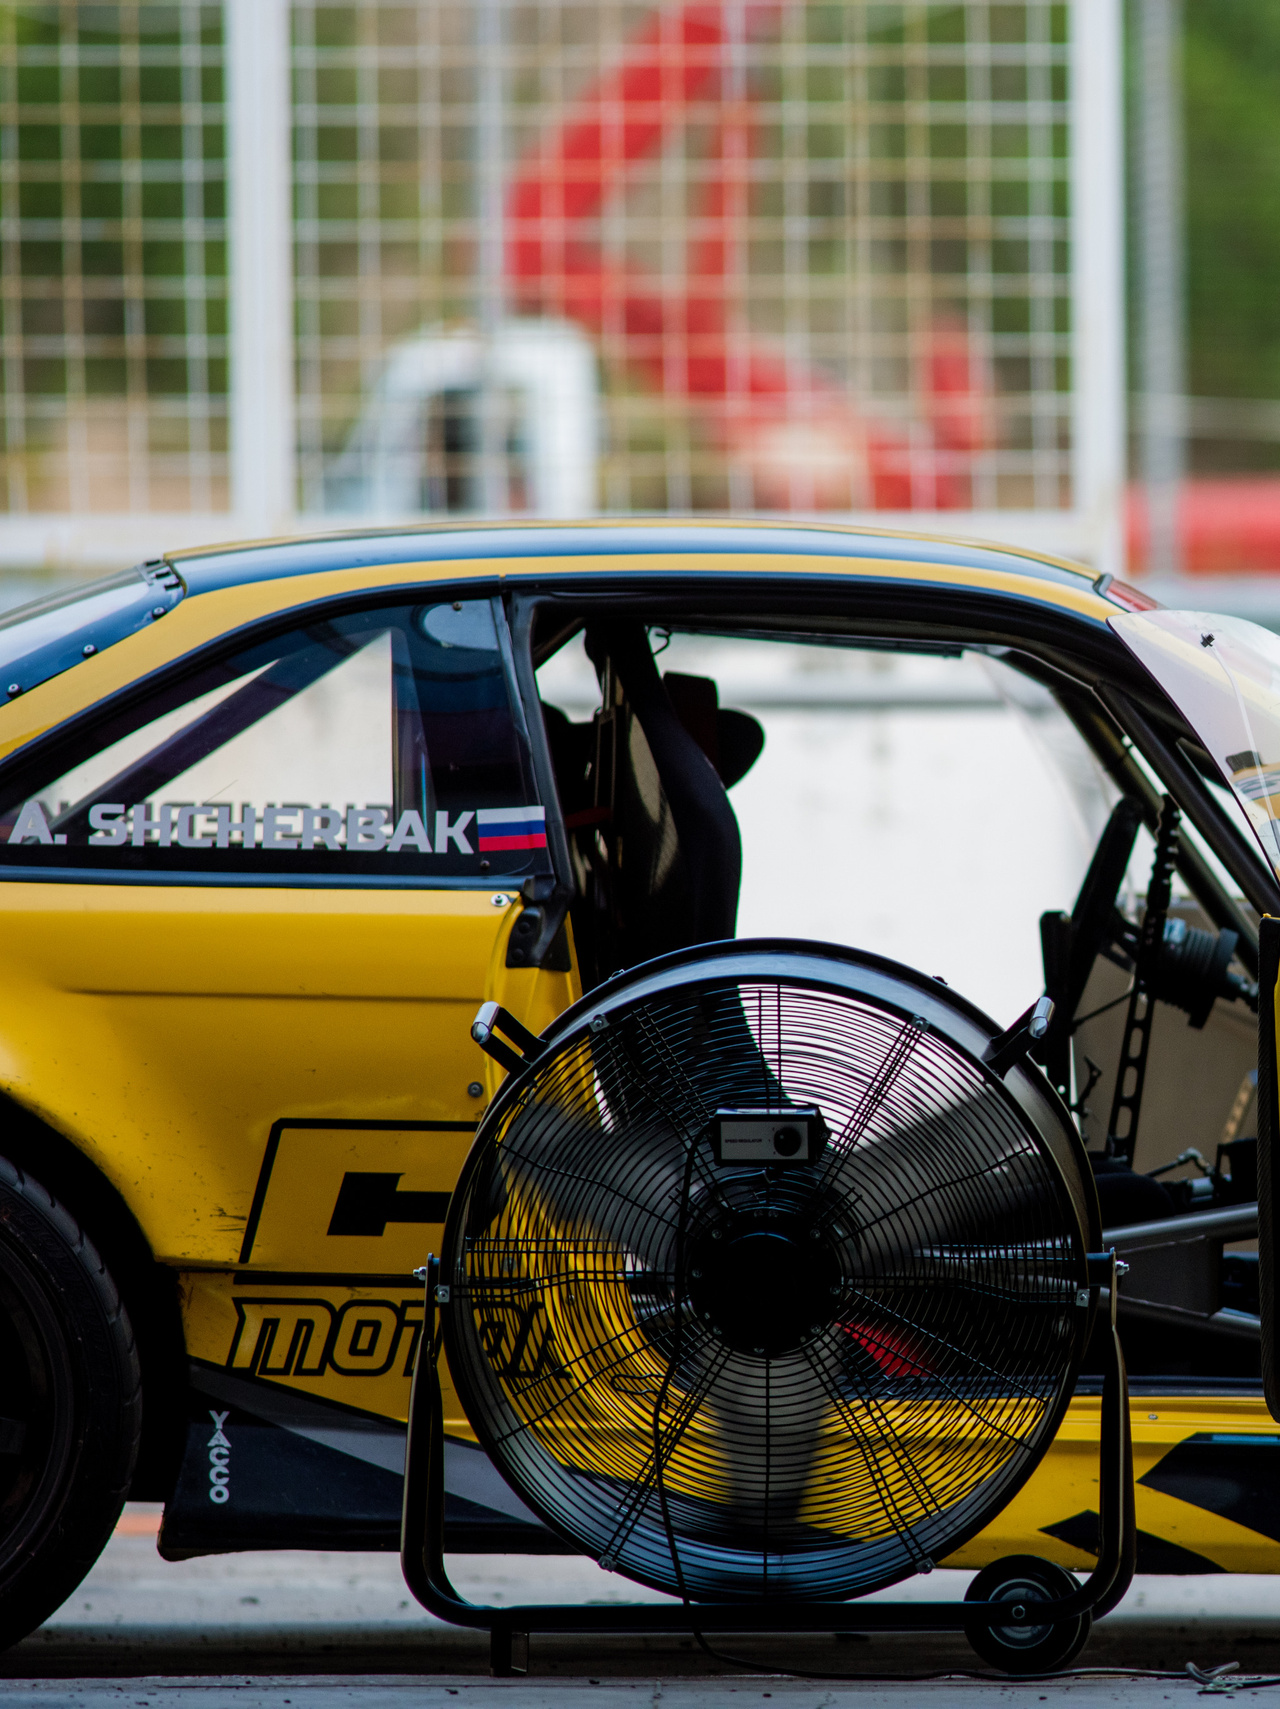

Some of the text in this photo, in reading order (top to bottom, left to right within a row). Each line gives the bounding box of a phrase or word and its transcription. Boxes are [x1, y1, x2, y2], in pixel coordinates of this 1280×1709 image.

[7, 802, 475, 854] A. SHCHERBAK
[206, 1409, 232, 1504] YACCO
